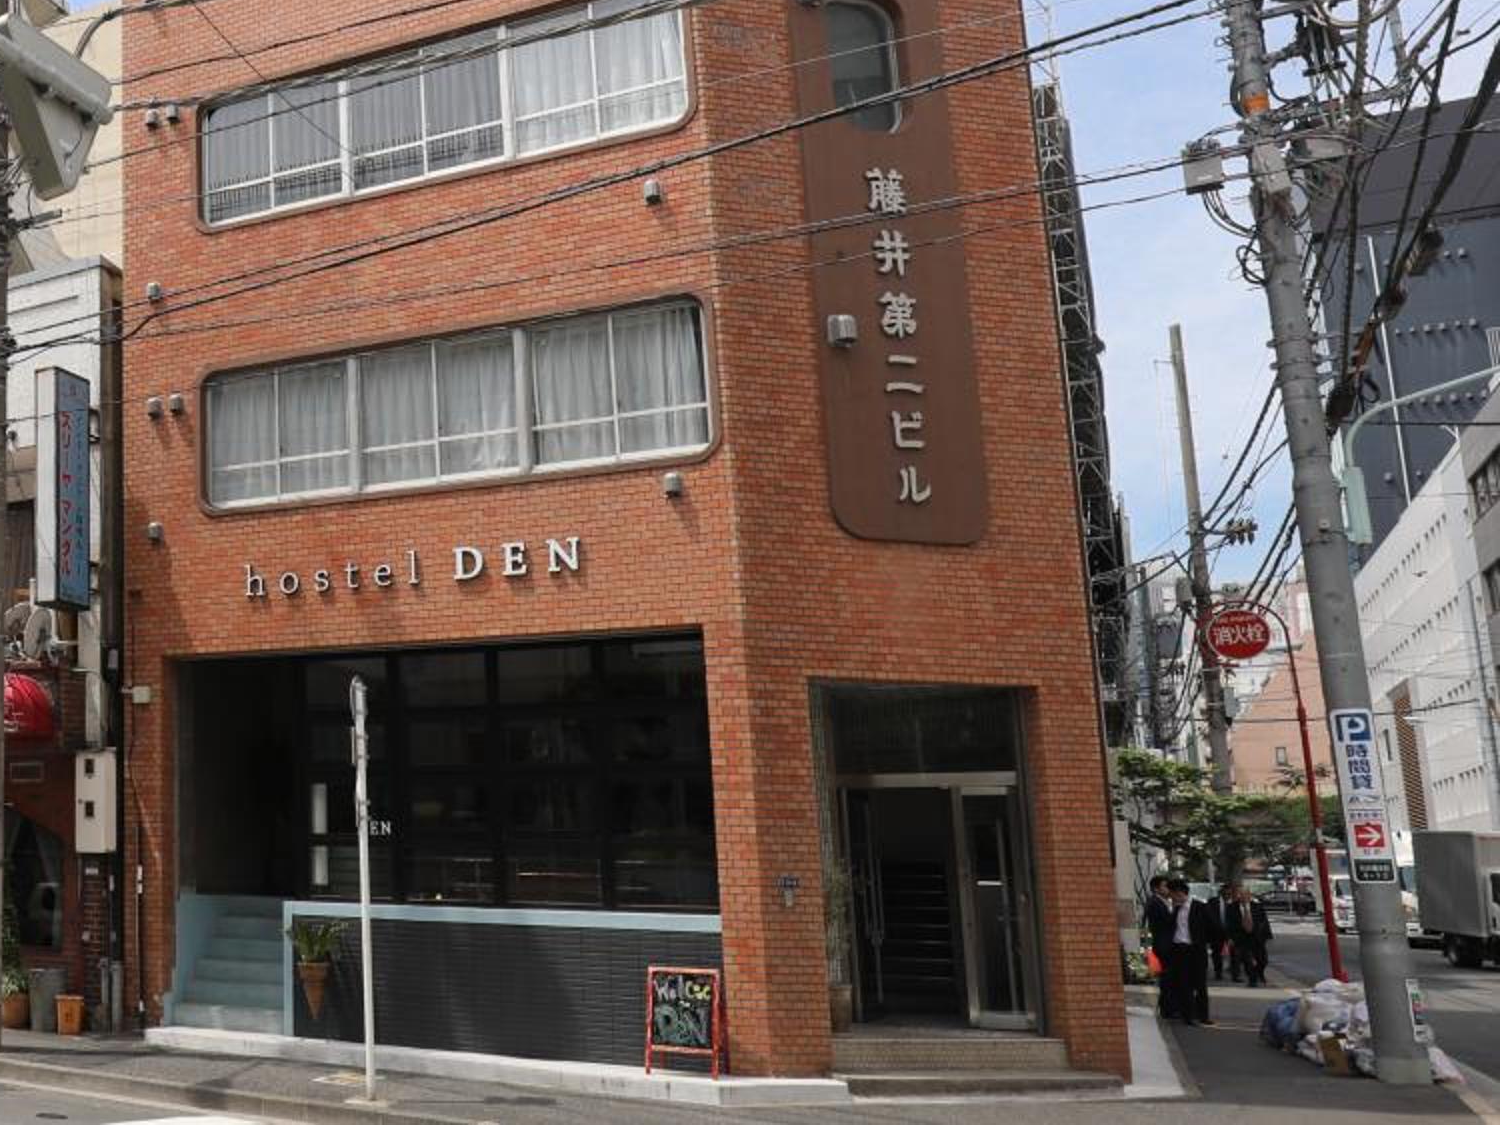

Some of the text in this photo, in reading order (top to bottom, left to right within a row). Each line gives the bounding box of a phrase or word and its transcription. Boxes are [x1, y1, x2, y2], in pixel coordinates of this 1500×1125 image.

[866, 167, 932, 503] 藤井第二ビル
[244, 536, 581, 598] hostel DEN
[1212, 623, 1267, 645] 消火栓
[1340, 716, 1367, 743] P
[1345, 744, 1375, 790] 時間貸
[369, 820, 391, 835] EN
